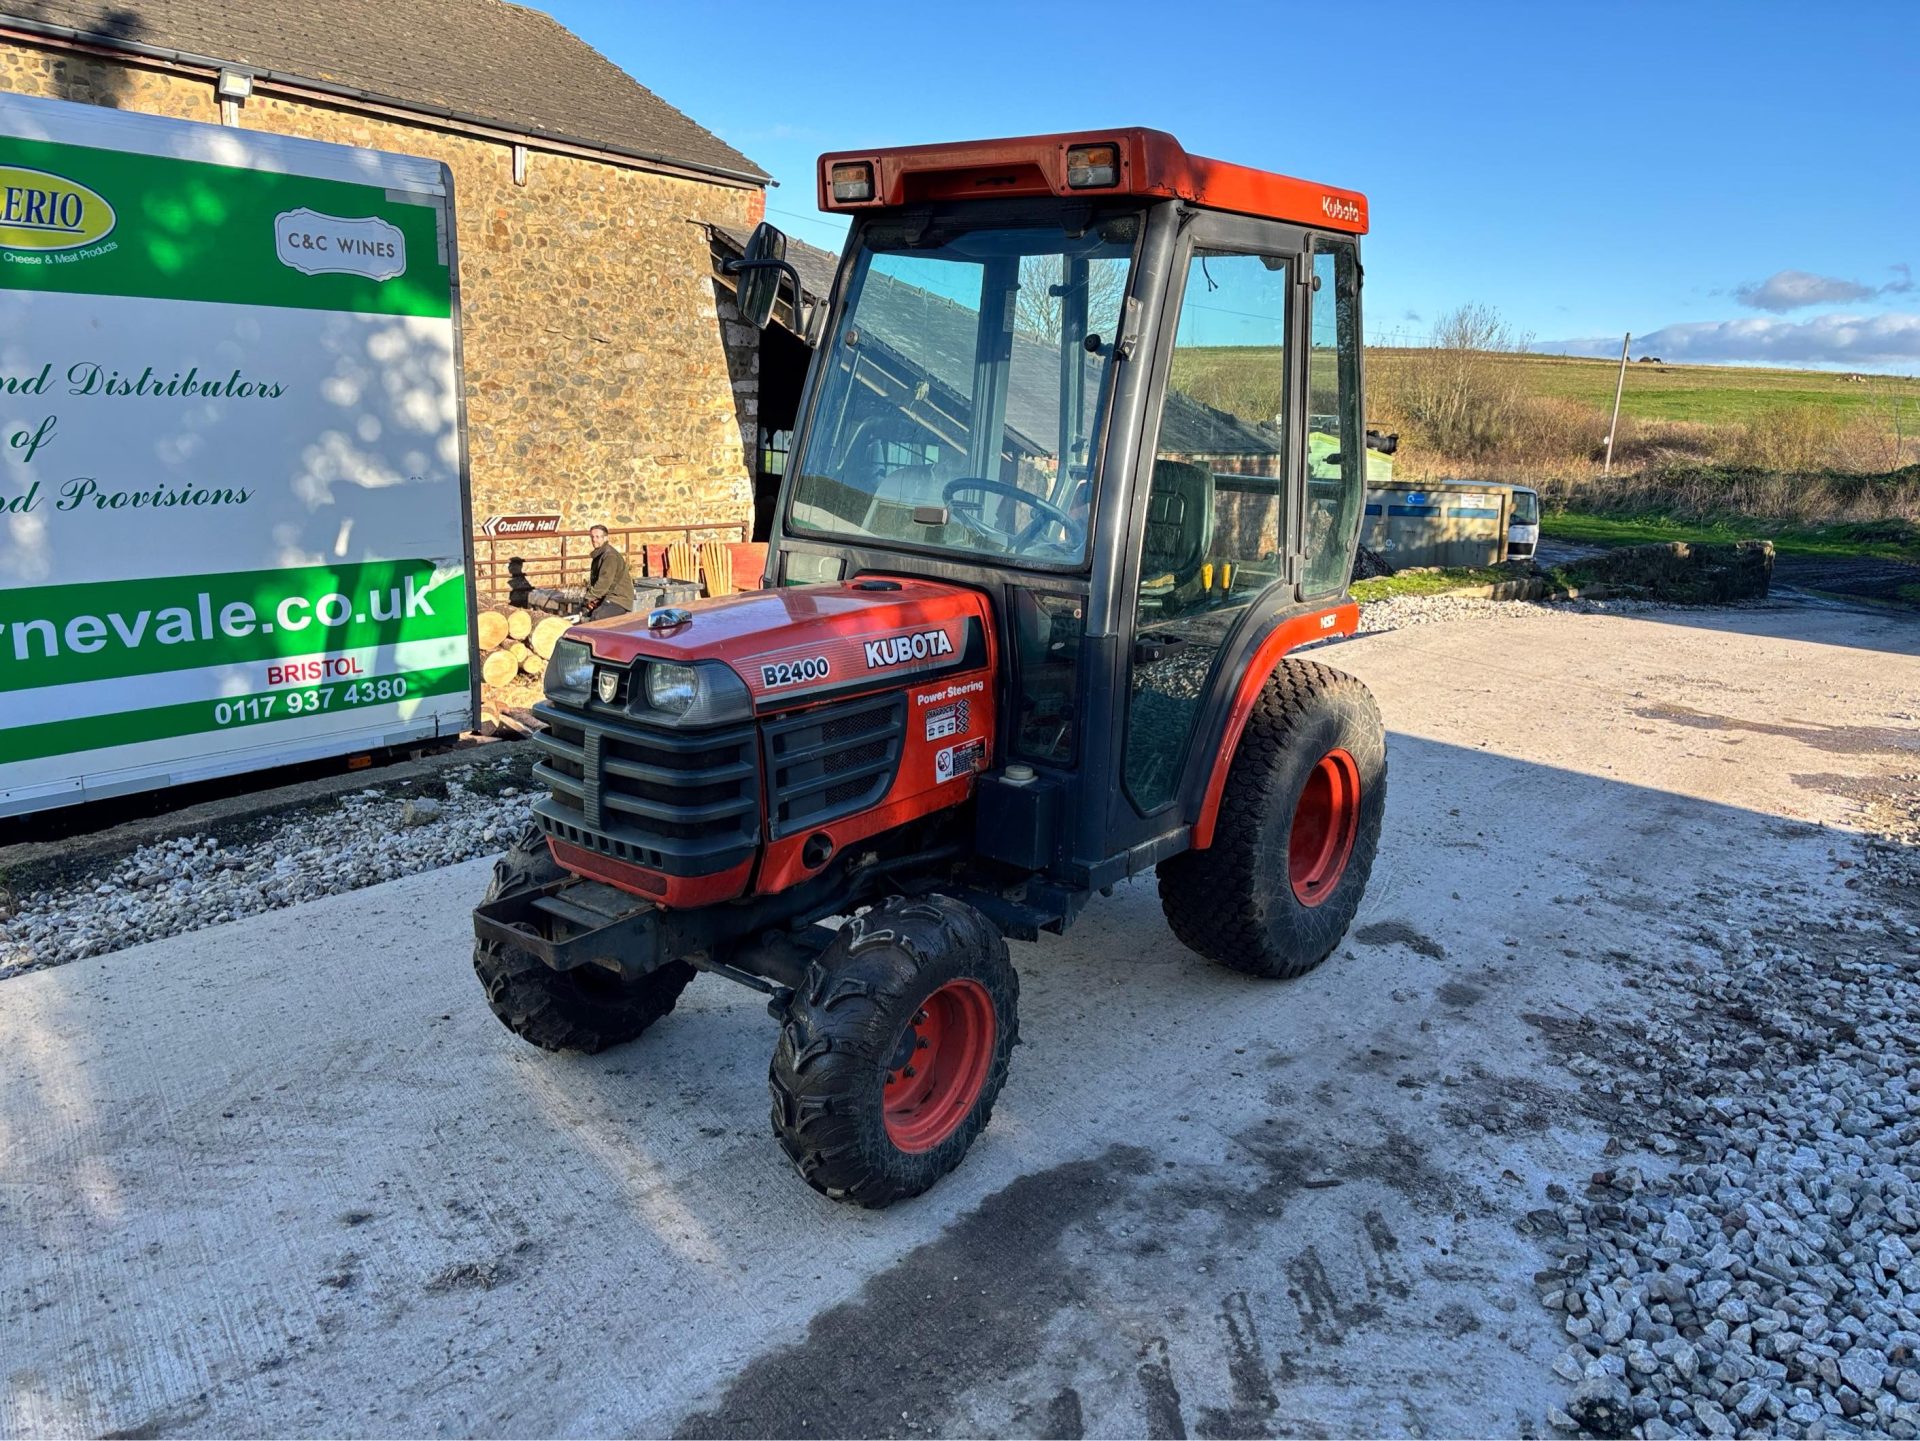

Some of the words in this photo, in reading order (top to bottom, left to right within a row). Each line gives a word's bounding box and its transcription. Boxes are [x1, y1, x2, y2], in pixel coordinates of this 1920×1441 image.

[0, 187, 83, 228] ERIO
[1322, 195, 1360, 222] Kubota
[3, 252, 42, 264] Cheese
[44, 254, 53, 264] &
[54, 253, 80, 263] Meat
[80, 241, 118, 258] Products
[288, 232, 328, 251] C&C
[336, 237, 395, 258] WINES
[67, 361, 289, 399] Distributors
[10, 414, 58, 463] of
[56, 477, 255, 512] Provisions
[498, 521, 535, 532] Oxcliffe
[536, 520, 556, 531] Hall
[0, 575, 436, 661] nevale.co.uk
[267, 657, 364, 685] BRISTOL
[761, 656, 830, 688] B2400
[863, 629, 954, 669] KUBOTA
[214, 696, 277, 725] 0117
[286, 687, 335, 714] 937
[344, 677, 407, 704] 4380
[917, 691, 947, 706] Power
[947, 681, 984, 698] Steering
